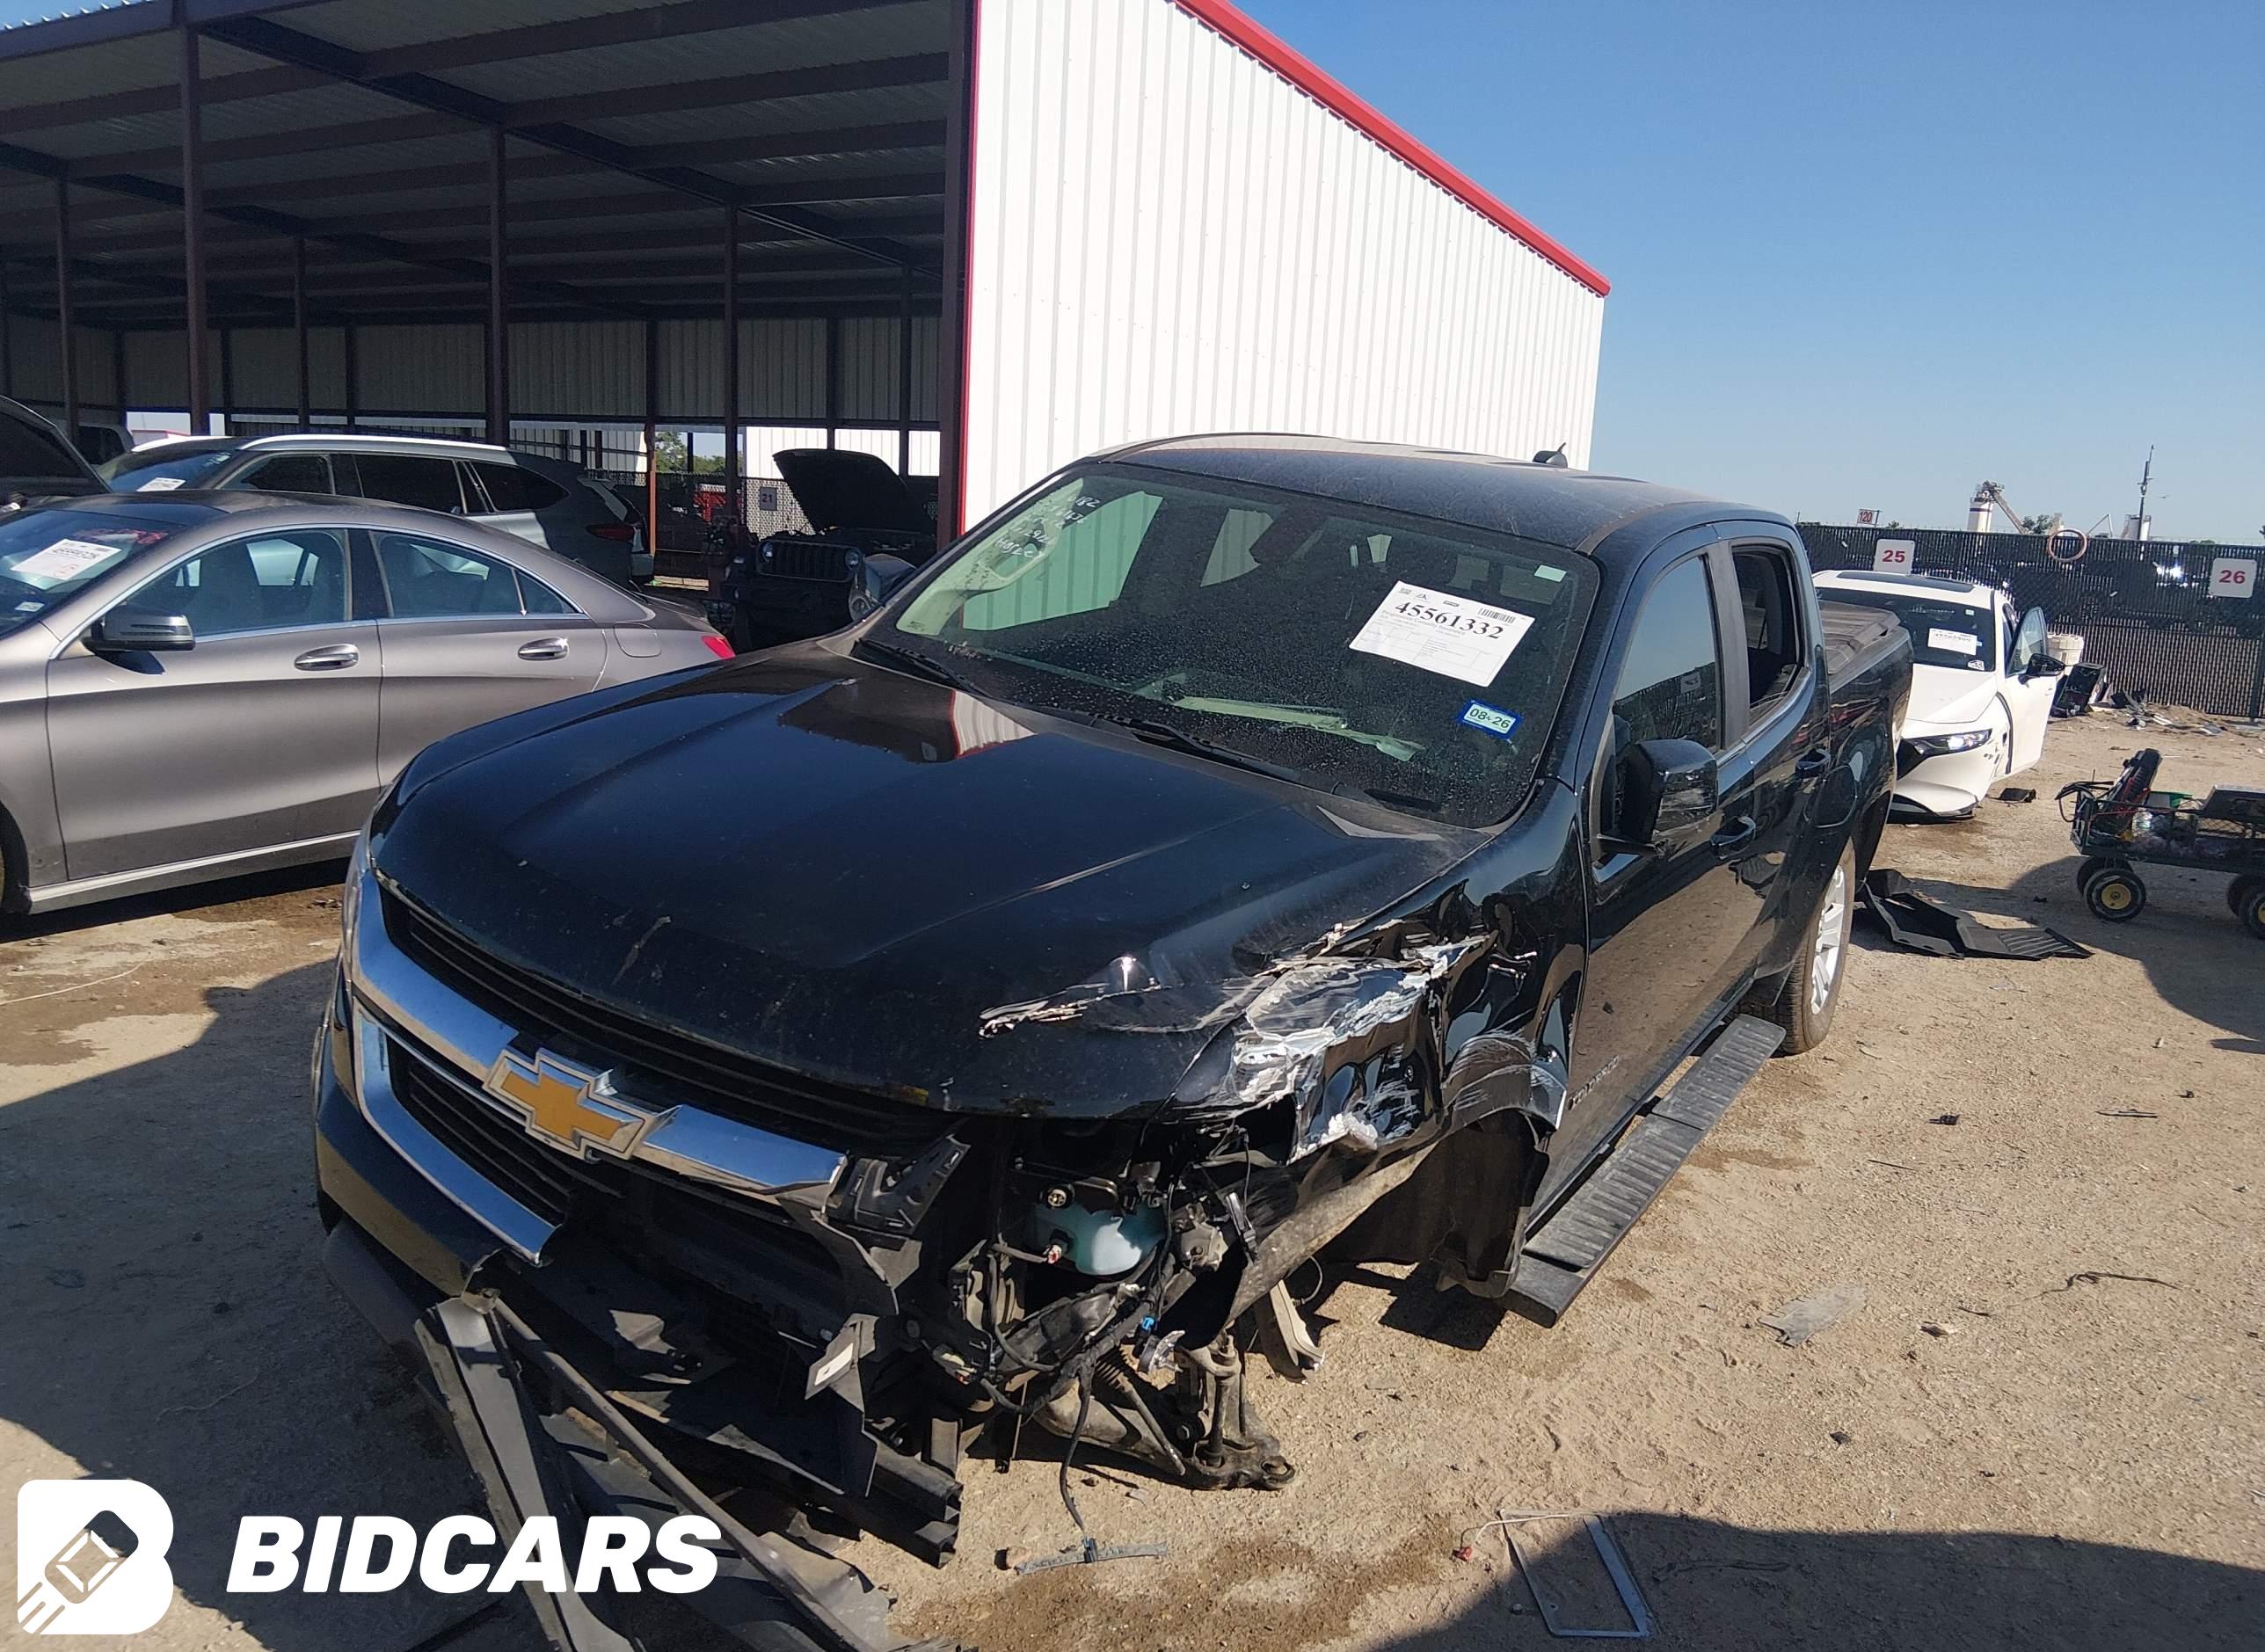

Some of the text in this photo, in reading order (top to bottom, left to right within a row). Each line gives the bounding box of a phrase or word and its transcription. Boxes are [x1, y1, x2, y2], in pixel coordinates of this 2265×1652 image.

[761, 493, 773, 504] 21
[1859, 511, 1873, 523] 120
[1882, 549, 1905, 564] 25
[2218, 570, 2246, 584] 26
[1395, 601, 1504, 639] 45561332
